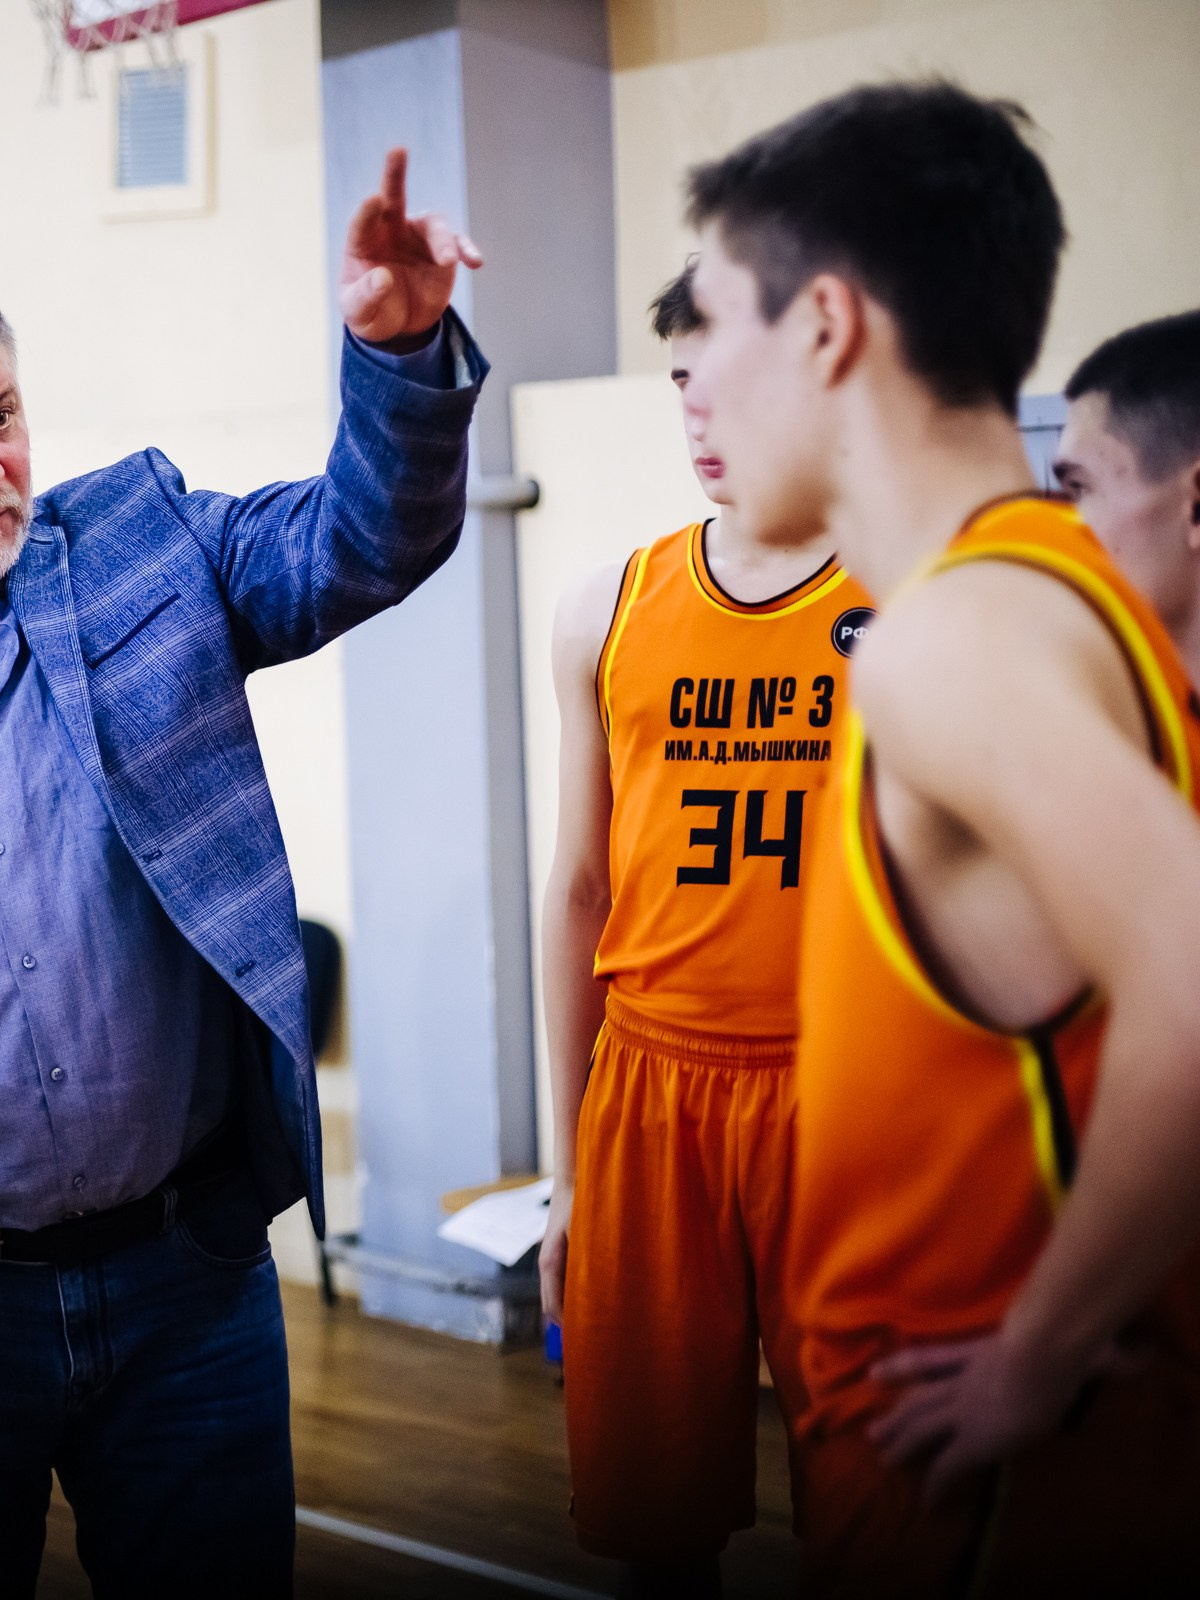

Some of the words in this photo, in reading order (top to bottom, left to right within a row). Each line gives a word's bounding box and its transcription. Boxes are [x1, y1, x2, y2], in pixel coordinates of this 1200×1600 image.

[840, 626, 870, 640] РФ
[669, 677, 735, 729] СШ
[807, 675, 835, 728] 3
[664, 739, 832, 765] ИМ.А.Д.МЫШКИНА
[676, 789, 808, 891] 34
